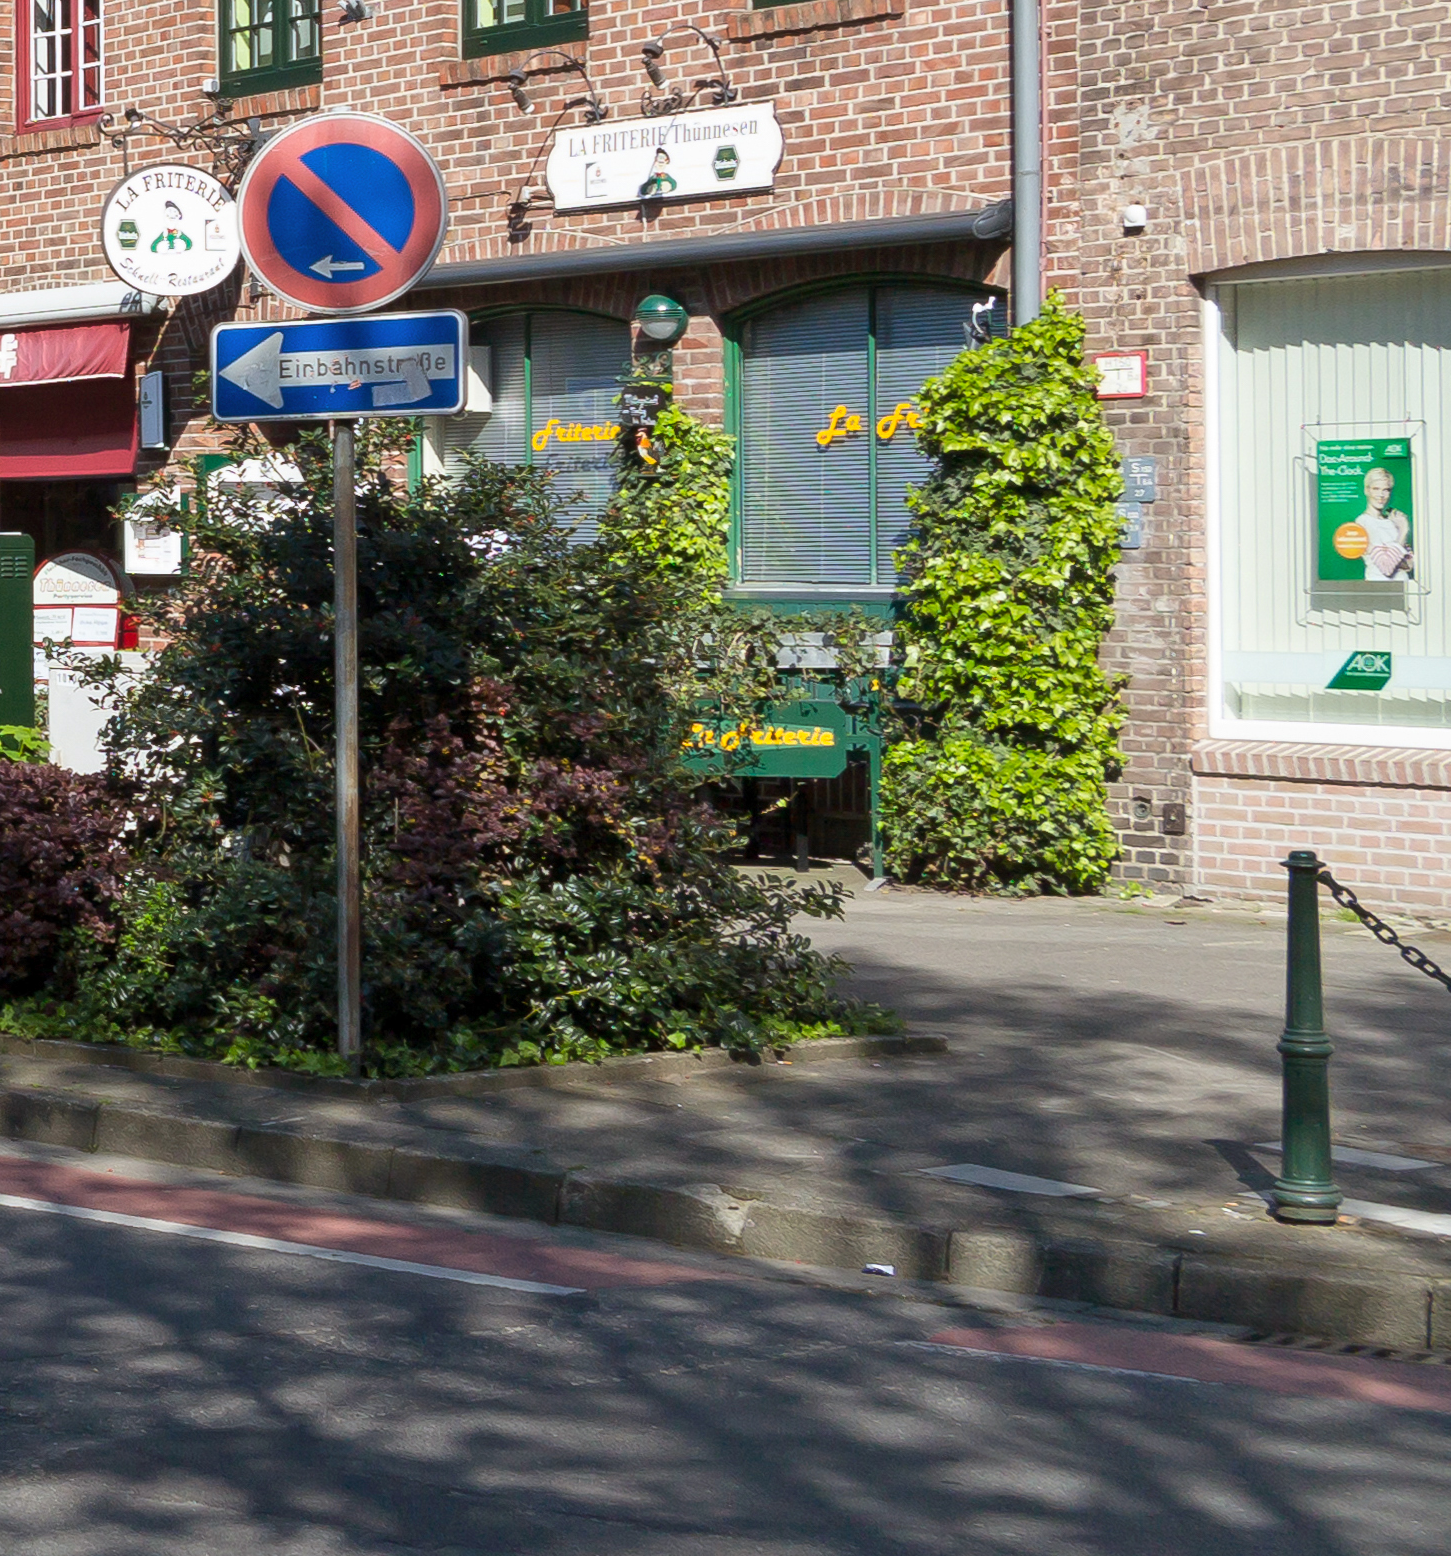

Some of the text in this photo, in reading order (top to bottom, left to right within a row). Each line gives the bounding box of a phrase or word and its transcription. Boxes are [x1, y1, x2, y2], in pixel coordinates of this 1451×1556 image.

[569, 119, 759, 158] LA FRITERIE Thünnesen
[115, 172, 226, 213] LA FRITERIE
[816, 405, 861, 445] La
[1346, 653, 1390, 672] AOK
